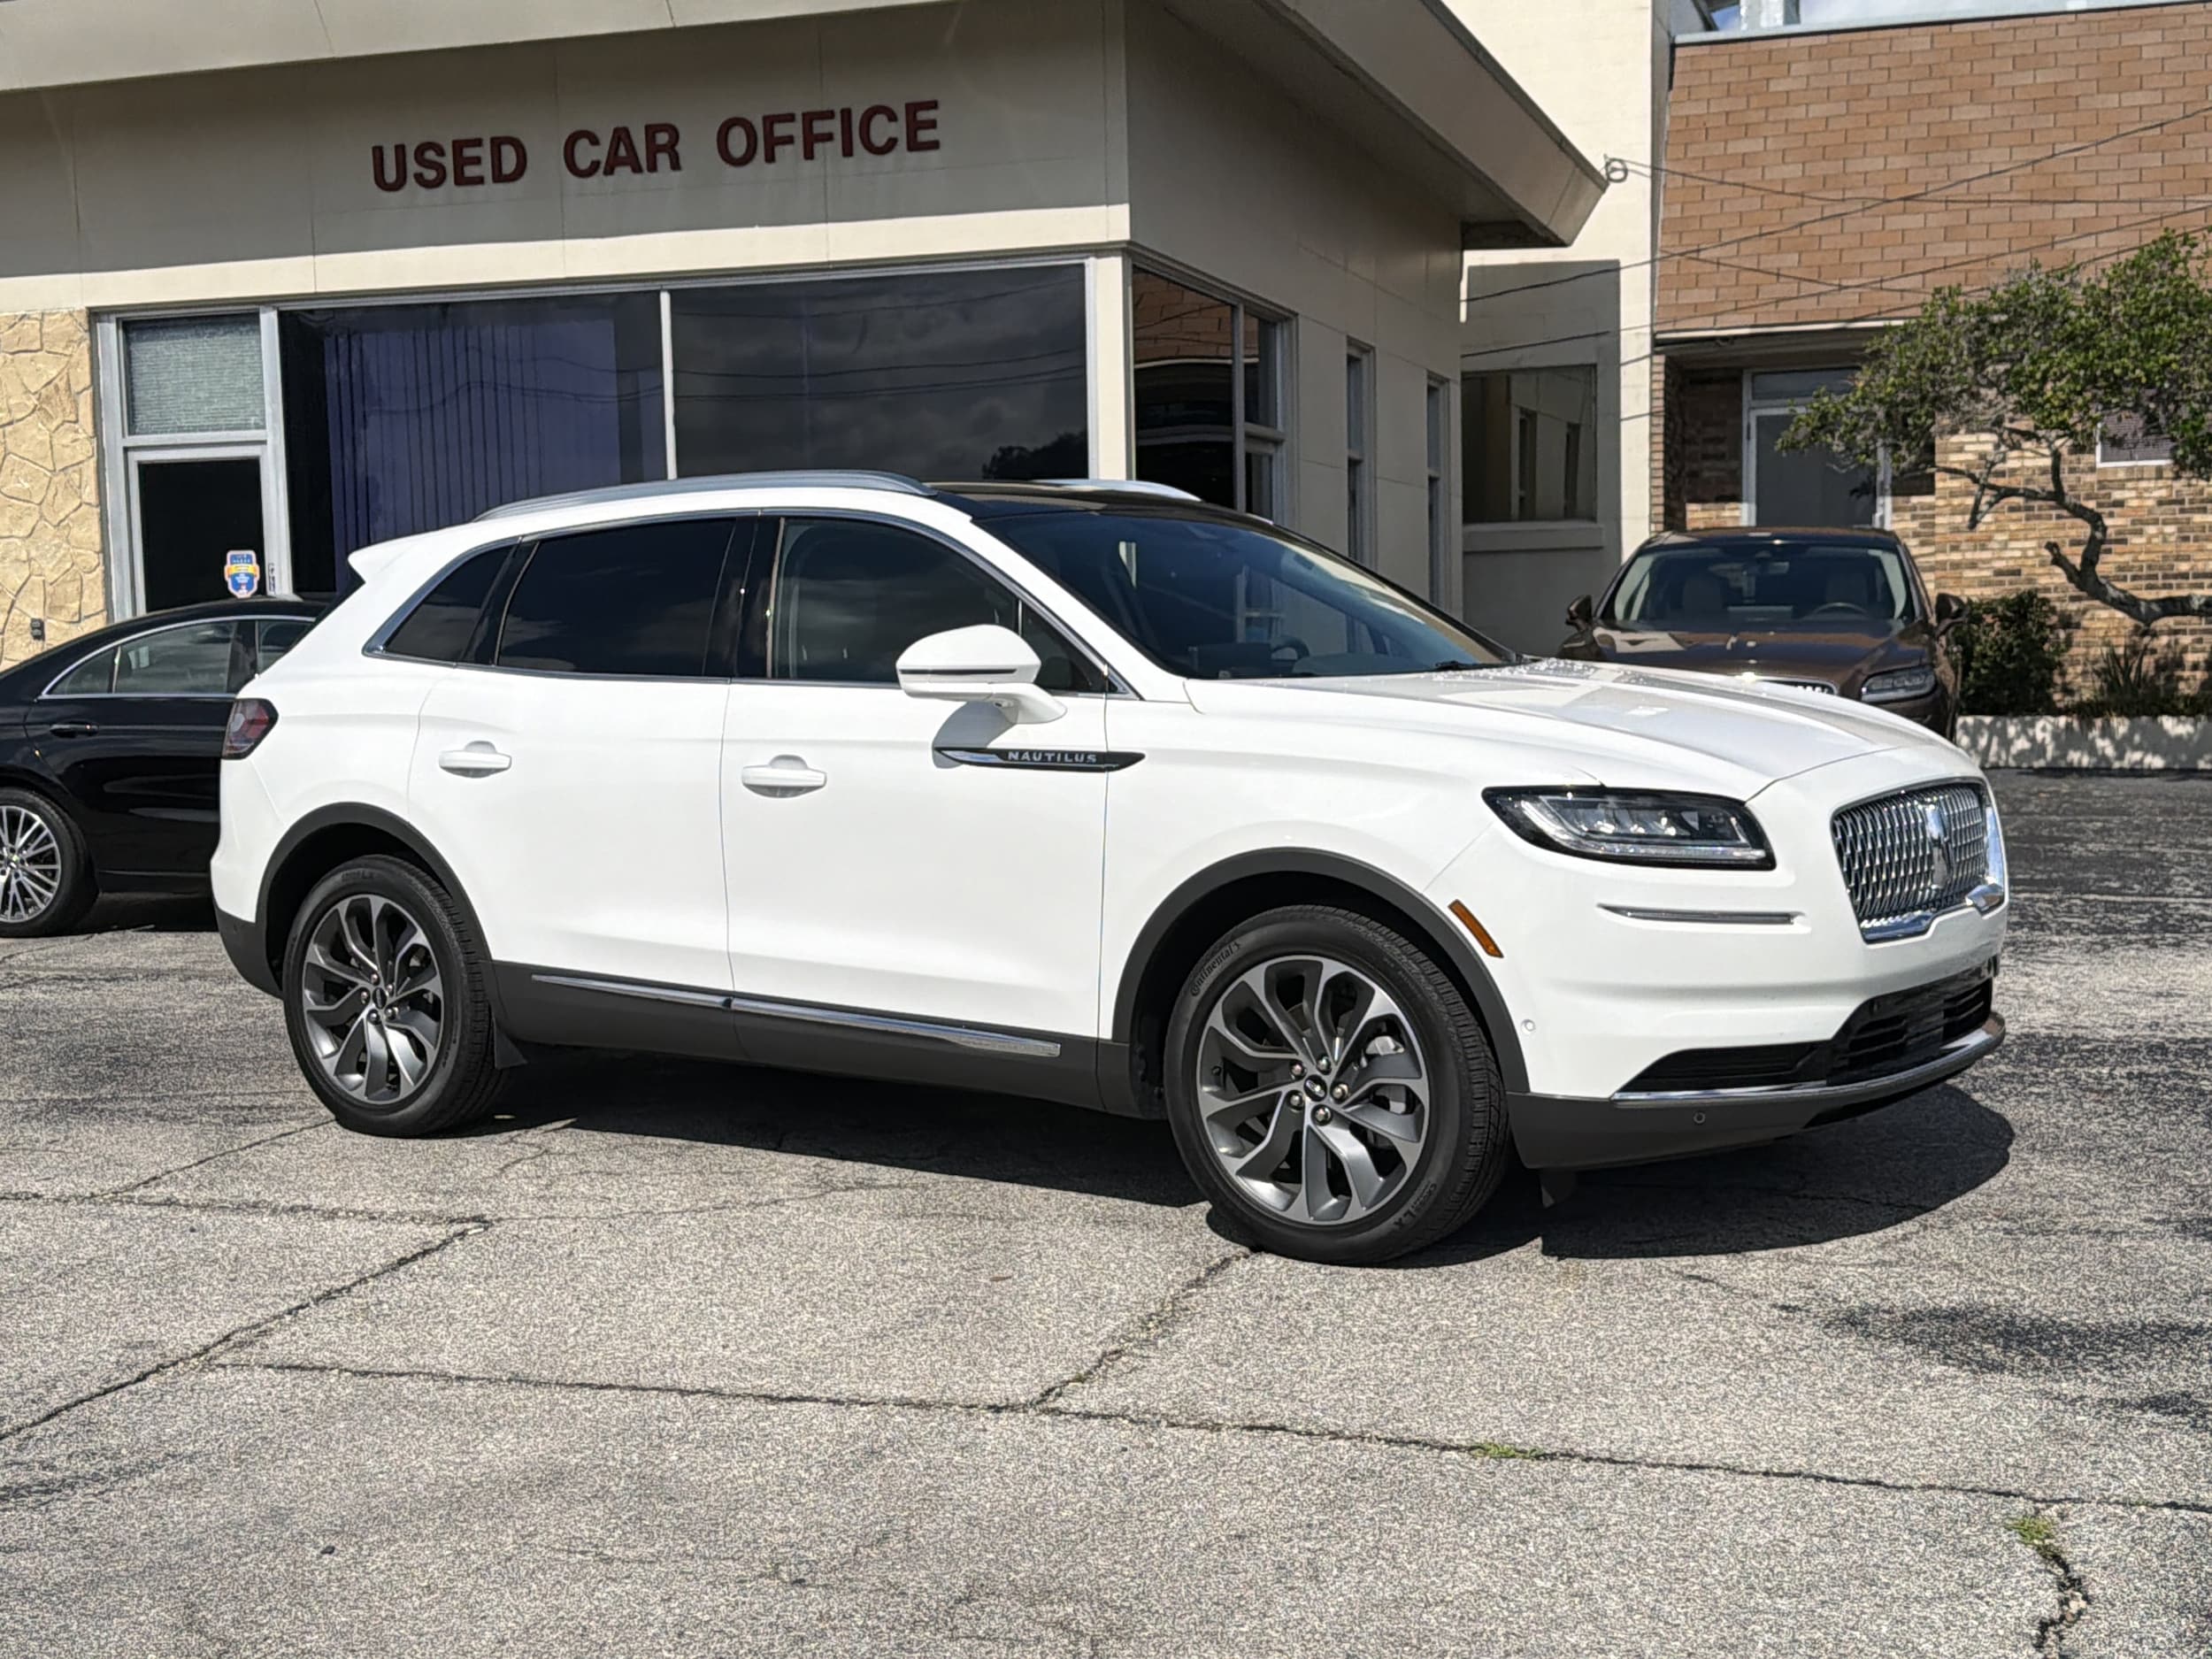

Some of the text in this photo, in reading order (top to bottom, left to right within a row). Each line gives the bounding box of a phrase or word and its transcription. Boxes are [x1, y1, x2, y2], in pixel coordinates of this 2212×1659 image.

[372, 100, 941, 192] USED CAR OFFICE
[1008, 751, 1097, 764] NAUTILUS
[1191, 944, 1233, 996] Continental
